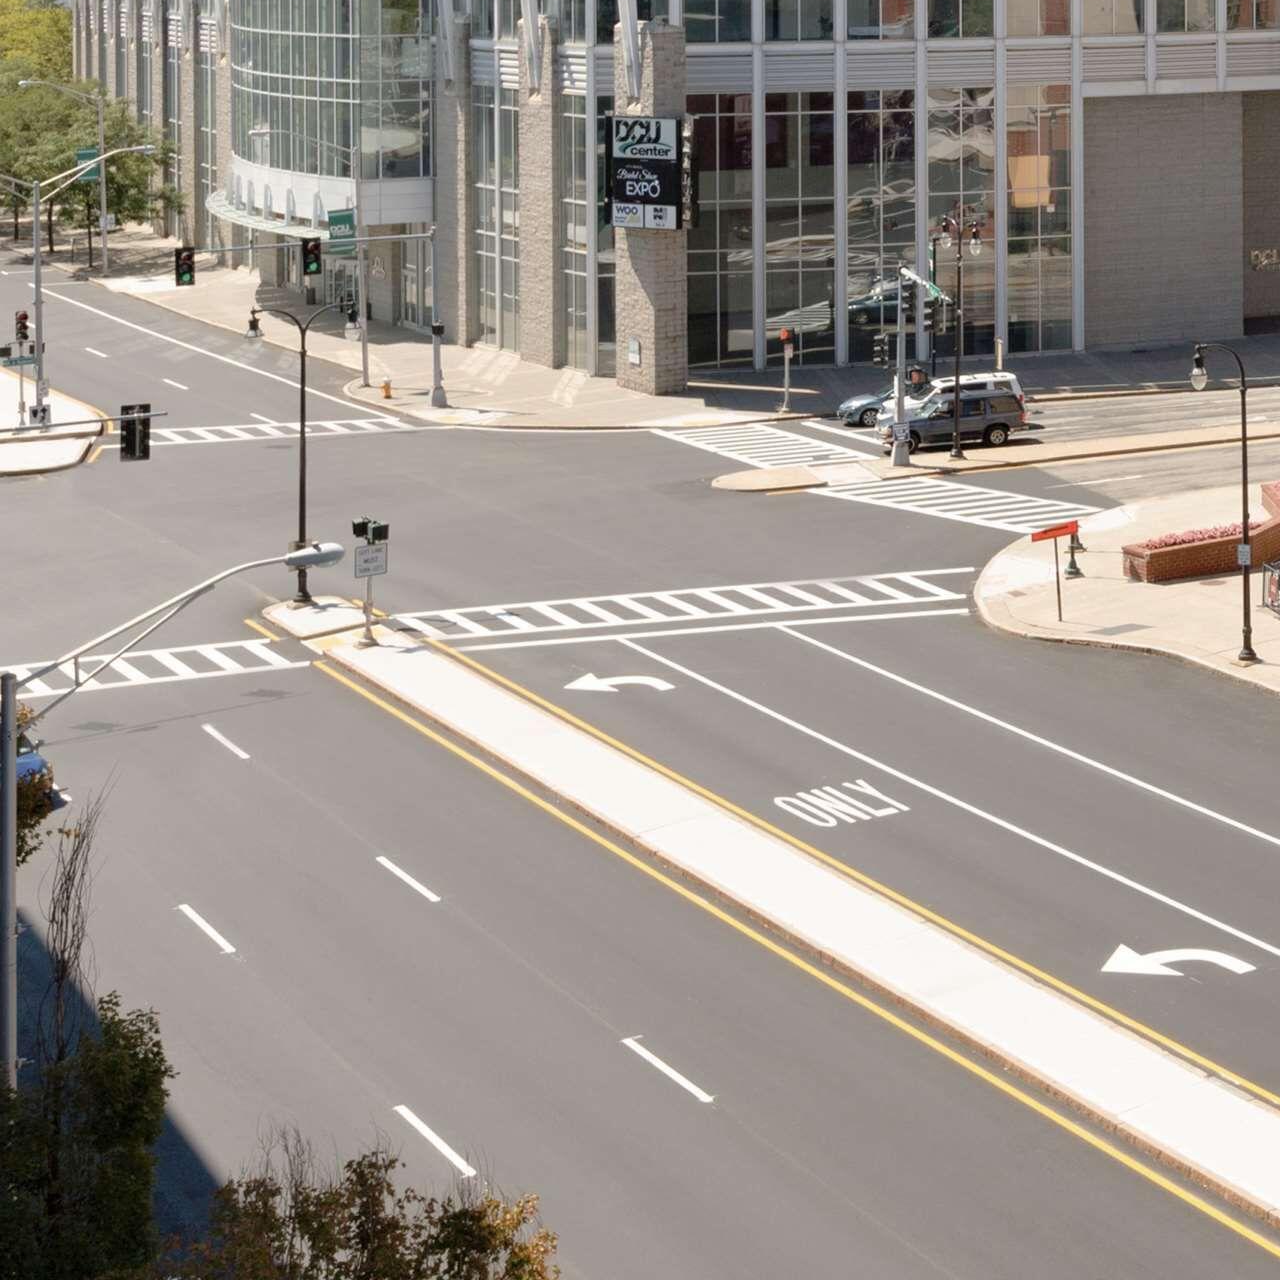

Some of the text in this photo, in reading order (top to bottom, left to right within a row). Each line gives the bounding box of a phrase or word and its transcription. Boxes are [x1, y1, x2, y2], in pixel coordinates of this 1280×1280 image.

[615, 120, 661, 144] DCU
[630, 146, 672, 157] center
[626, 180, 660, 198] EXPO
[773, 779, 911, 827] ONLY
